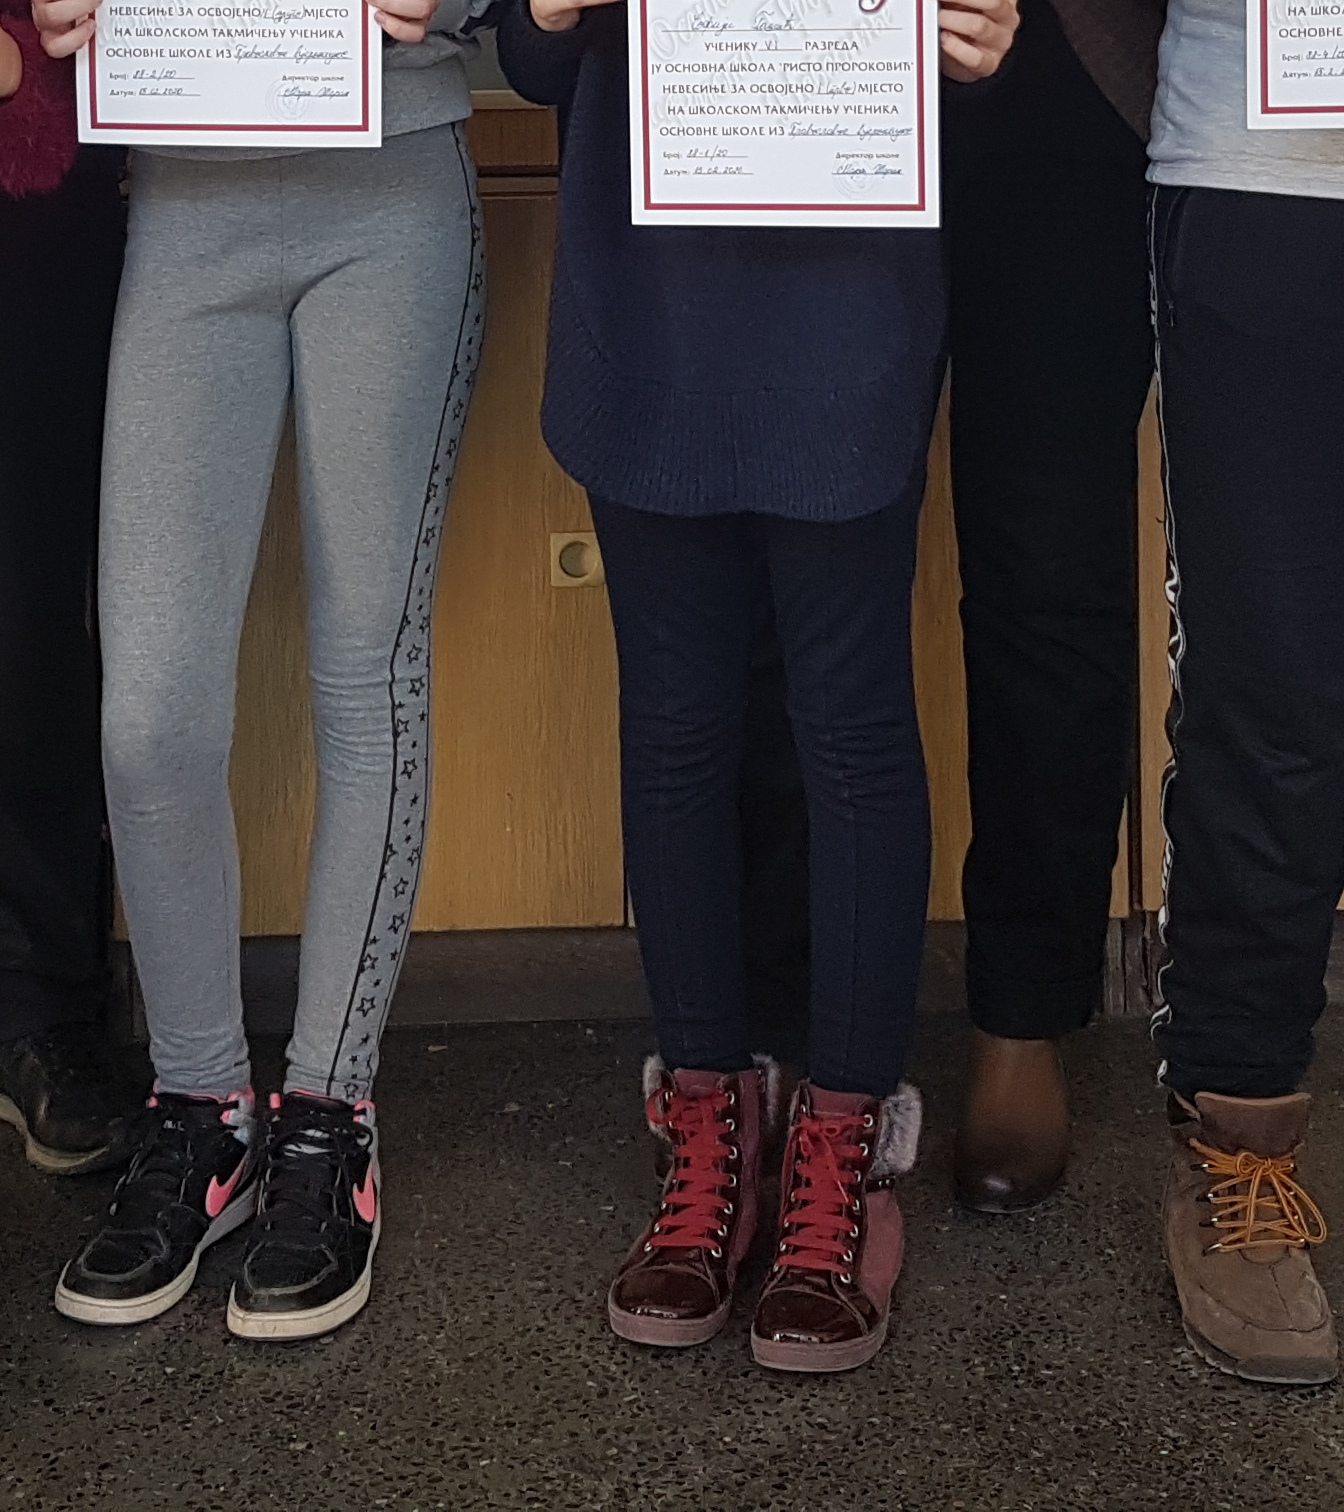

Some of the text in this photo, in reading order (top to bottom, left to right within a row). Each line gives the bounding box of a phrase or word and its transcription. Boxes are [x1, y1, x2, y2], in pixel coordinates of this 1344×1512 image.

[109, 6, 174, 17] НЕВЕСИЊЕ
[177, 6, 194, 17] ЗА
[197, 7, 263, 18] ОСВОЈЕНО
[303, 8, 349, 20] МЈЕСТО
[1287, 6, 1307, 17] НА
[114, 27, 345, 39] НА ШКОЛСКОМ ТАКМИЧЕЊУ УЧЕНИКА
[1278, 26, 1343, 39] ОСНОВНЕ
[704, 41, 758, 52] УЧЕНИКУ
[804, 40, 859, 51] РАЗРЕДА
[105, 47, 166, 58] ОСНОВНЕ
[168, 48, 212, 59] ШКОЛЕ
[215, 48, 232, 59] ИЗ
[651, 63, 662, 75] ЈУ
[664, 63, 727, 73] ОСНОВНА
[729, 62, 776, 73] ШКОЛА
[662, 84, 727, 94] НЕВЕСИЊЕ
[730, 83, 747, 94] ЗА
[749, 83, 815, 96] ОСВОЈЕНО
[857, 82, 904, 95] МЈЕСТО
[667, 104, 899, 116] НА ШКОЛСКОМ ТАКМИЧЕЊУ УЧЕНИКА
[659, 126, 718, 137] ОСНОВНЕ
[721, 126, 765, 136] ШКОЛЕ
[768, 126, 785, 136] ИЗ
